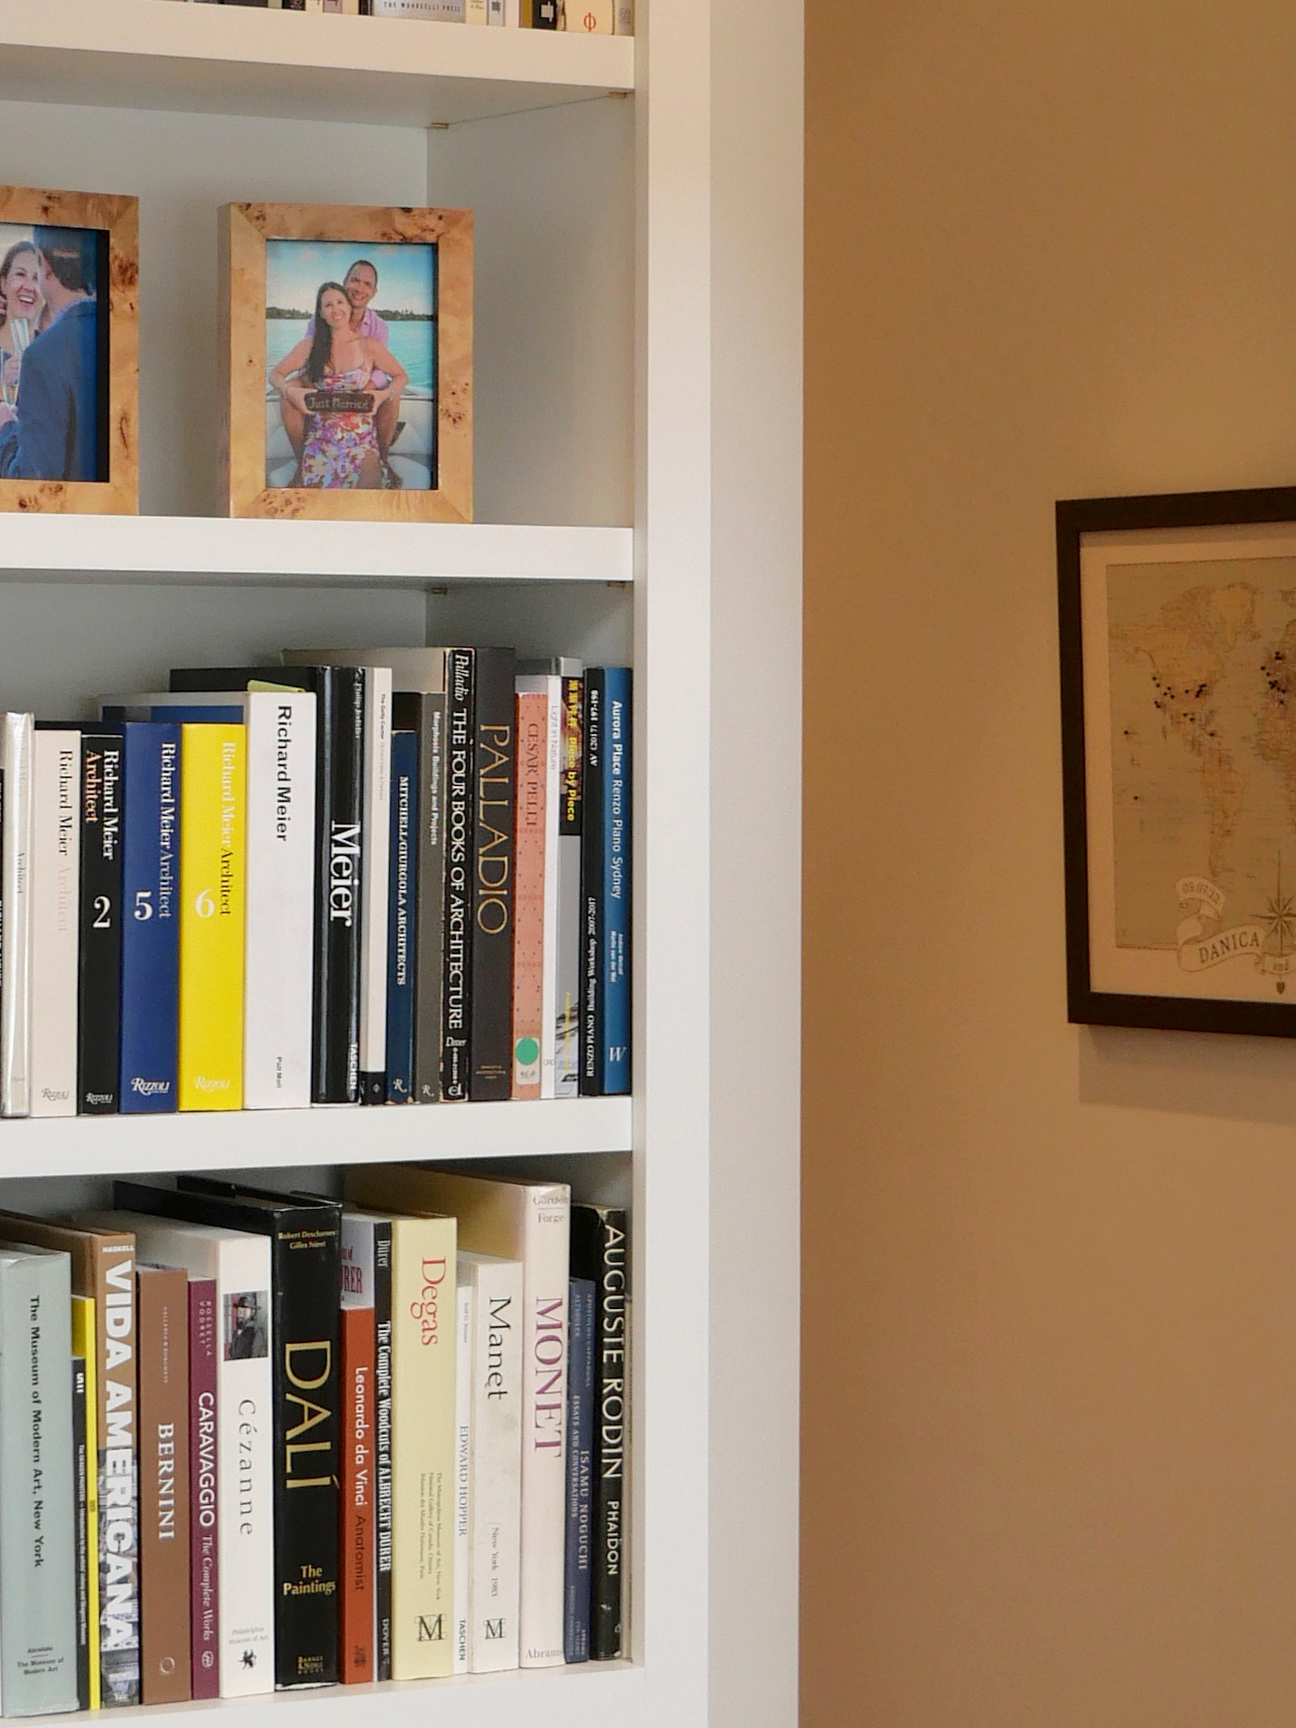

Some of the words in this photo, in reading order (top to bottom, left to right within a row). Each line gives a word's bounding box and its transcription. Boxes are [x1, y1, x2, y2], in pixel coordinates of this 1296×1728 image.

[452, 654, 467, 701] Palladio
[277, 705, 292, 783] Richard
[452, 708, 466, 744] THE
[451, 749, 467, 796] FOUR
[525, 781, 538, 826] PELLI
[277, 787, 291, 841] Meier
[451, 802, 466, 862] BOOKS
[478, 724, 510, 934] PALLADIO
[330, 820, 361, 926] Meier
[450, 867, 465, 890] OF
[447, 895, 465, 1028] ARCHITECTURE
[1198, 931, 1260, 963] DANICA
[1272, 960, 1289, 972] and
[106, 1260, 132, 1369] VIDA
[410, 1256, 446, 1346] Degas
[603, 1225, 623, 1363] AUGUSTE
[32, 1326, 40, 1388] Museum
[485, 1296, 511, 1400] Manet
[534, 1297, 562, 1458] MONET
[32, 1393, 41, 1405] of
[285, 1340, 340, 1489] DALÍ
[354, 1367, 367, 1438] Leonardo
[602, 1378, 623, 1478] RODIN
[33, 1410, 41, 1464] Modern
[198, 1392, 214, 1527] CARAVAGGIO
[239, 1400, 257, 1536] Cézanne
[355, 1444, 367, 1464] da
[458, 1425, 468, 1482] EDWARD
[32, 1470, 42, 1495] Art,
[158, 1423, 175, 1540] BERNINI
[355, 1468, 368, 1506] Vinci
[457, 1486, 468, 1537] HOPPER
[34, 1500, 42, 1528] New
[105, 1380, 132, 1651] AMERICANA
[607, 1501, 620, 1575] PHAIDON
[34, 1534, 43, 1567] York
[354, 1514, 366, 1590] Anatomist
[458, 1619, 467, 1661] TASCHEN
